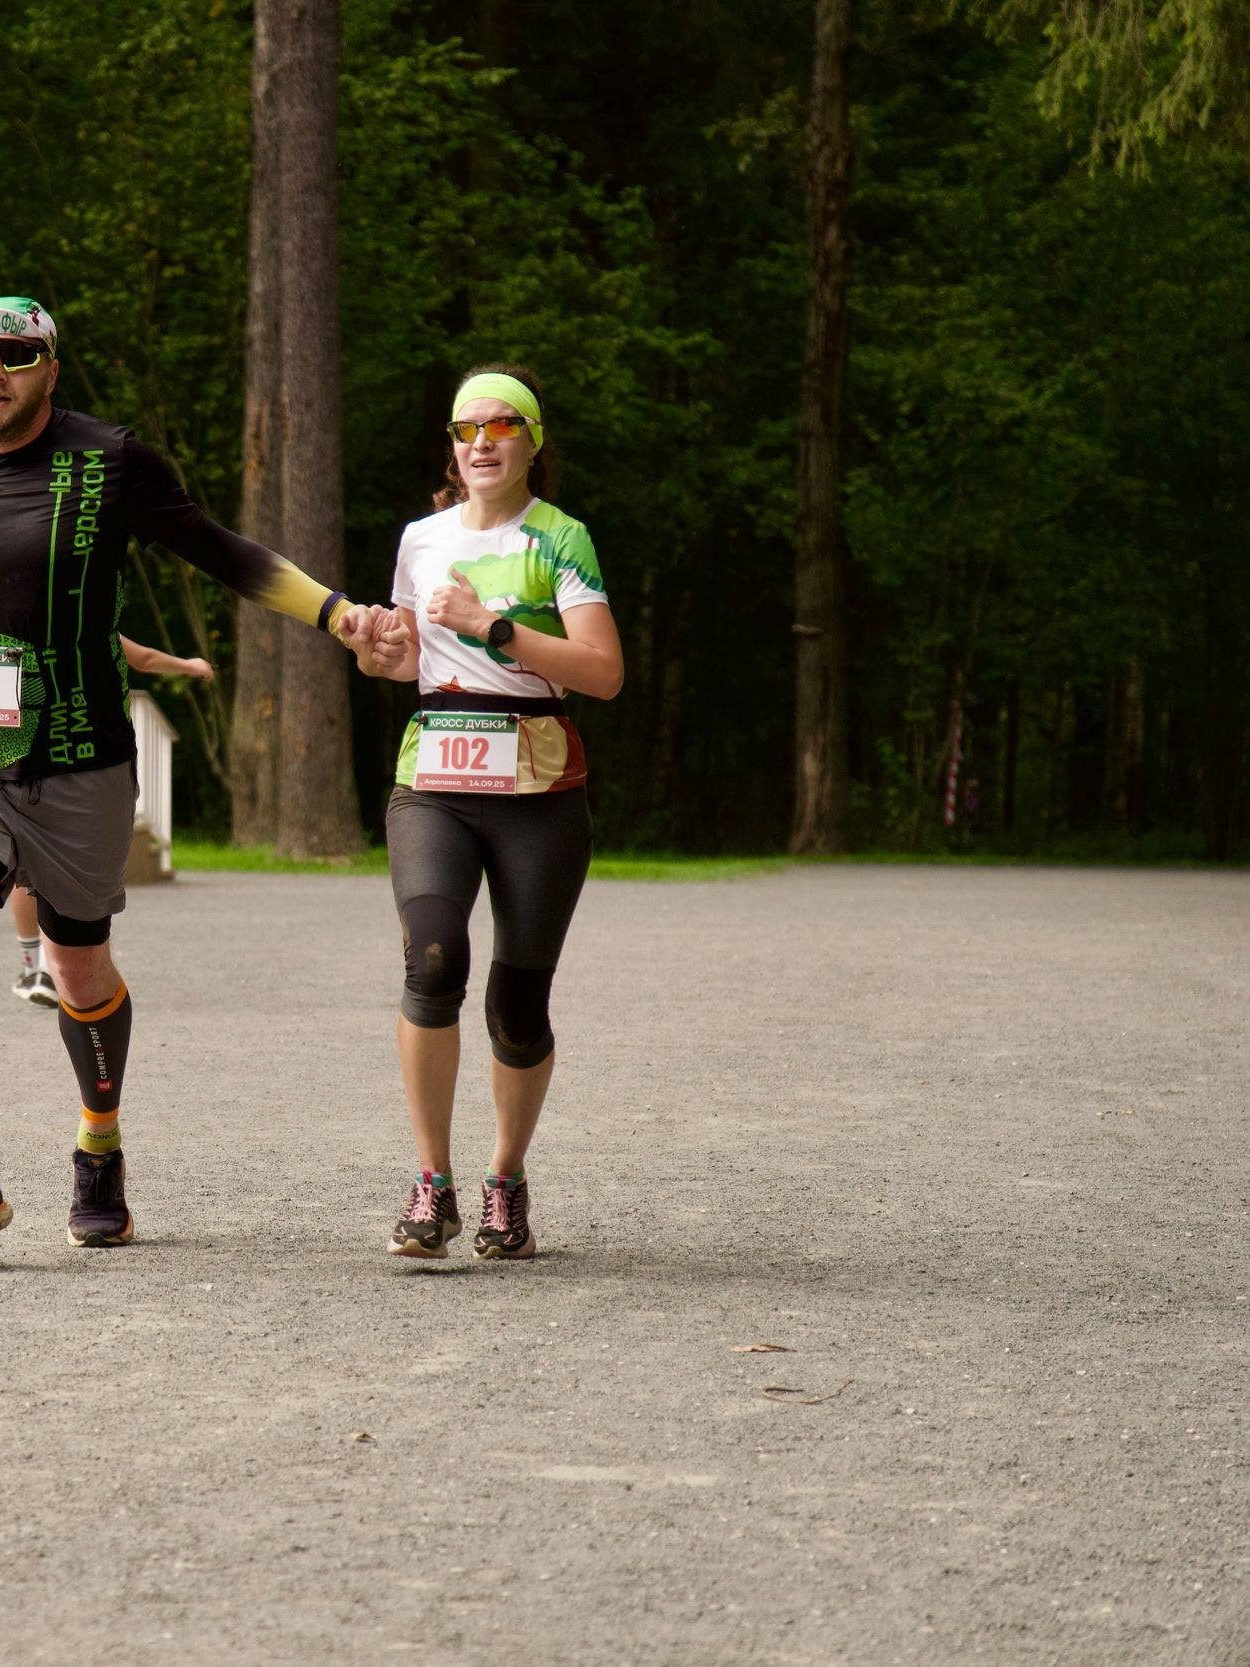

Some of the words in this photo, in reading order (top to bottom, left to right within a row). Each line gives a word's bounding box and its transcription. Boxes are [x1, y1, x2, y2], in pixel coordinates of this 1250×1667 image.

[429, 718, 463, 728] КРОСС
[465, 719, 507, 730] ДУБКИ
[438, 736, 490, 770] 102
[469, 779, 506, 789] 14.09.25
